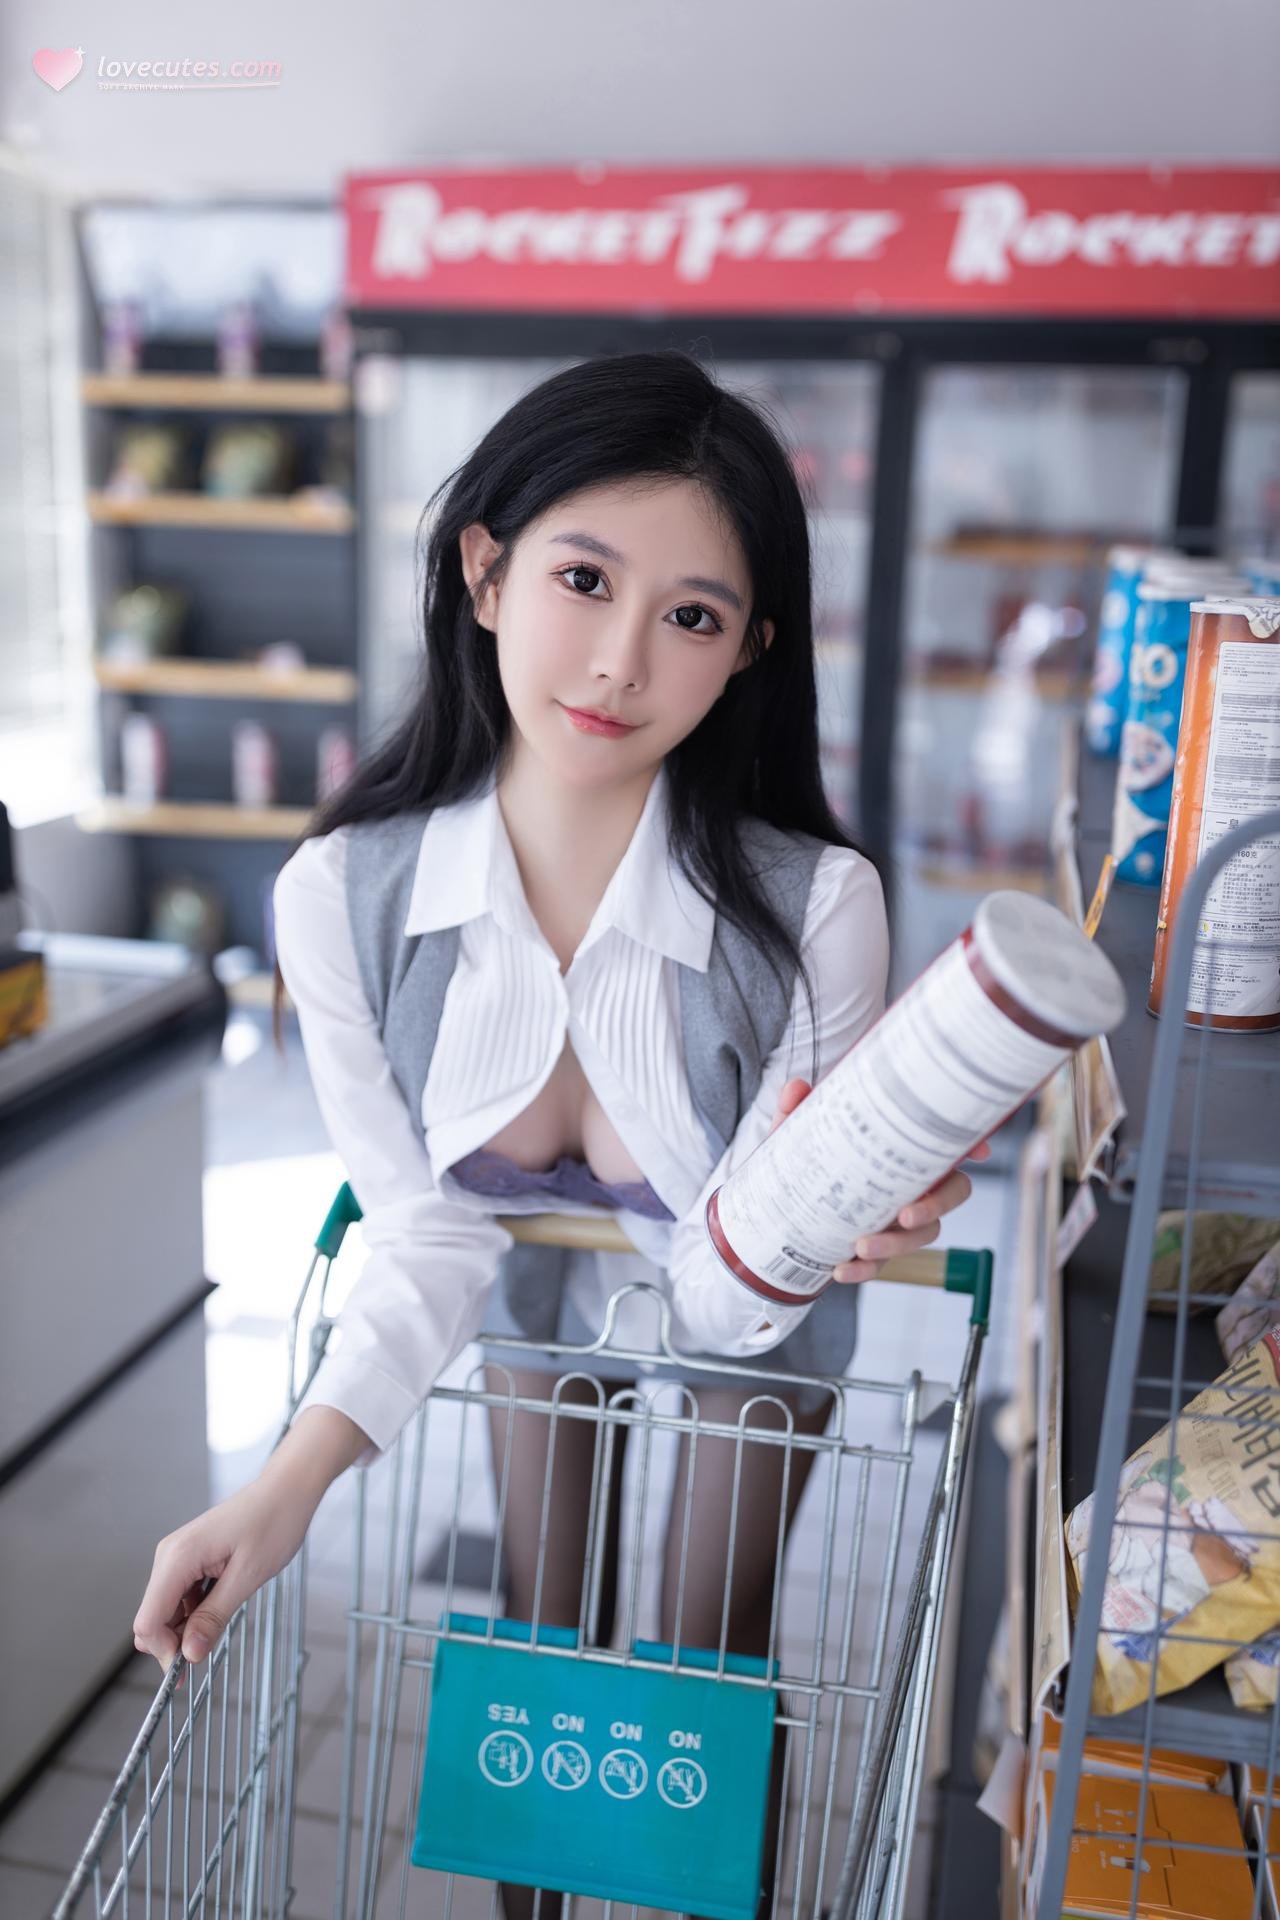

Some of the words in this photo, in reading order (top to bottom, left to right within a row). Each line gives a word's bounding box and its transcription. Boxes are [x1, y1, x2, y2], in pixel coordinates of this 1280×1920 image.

[488, 1704, 529, 1725] YES
[552, 1713, 585, 1732] NO
[610, 1721, 642, 1741] NO
[668, 1730, 701, 1750] NO
